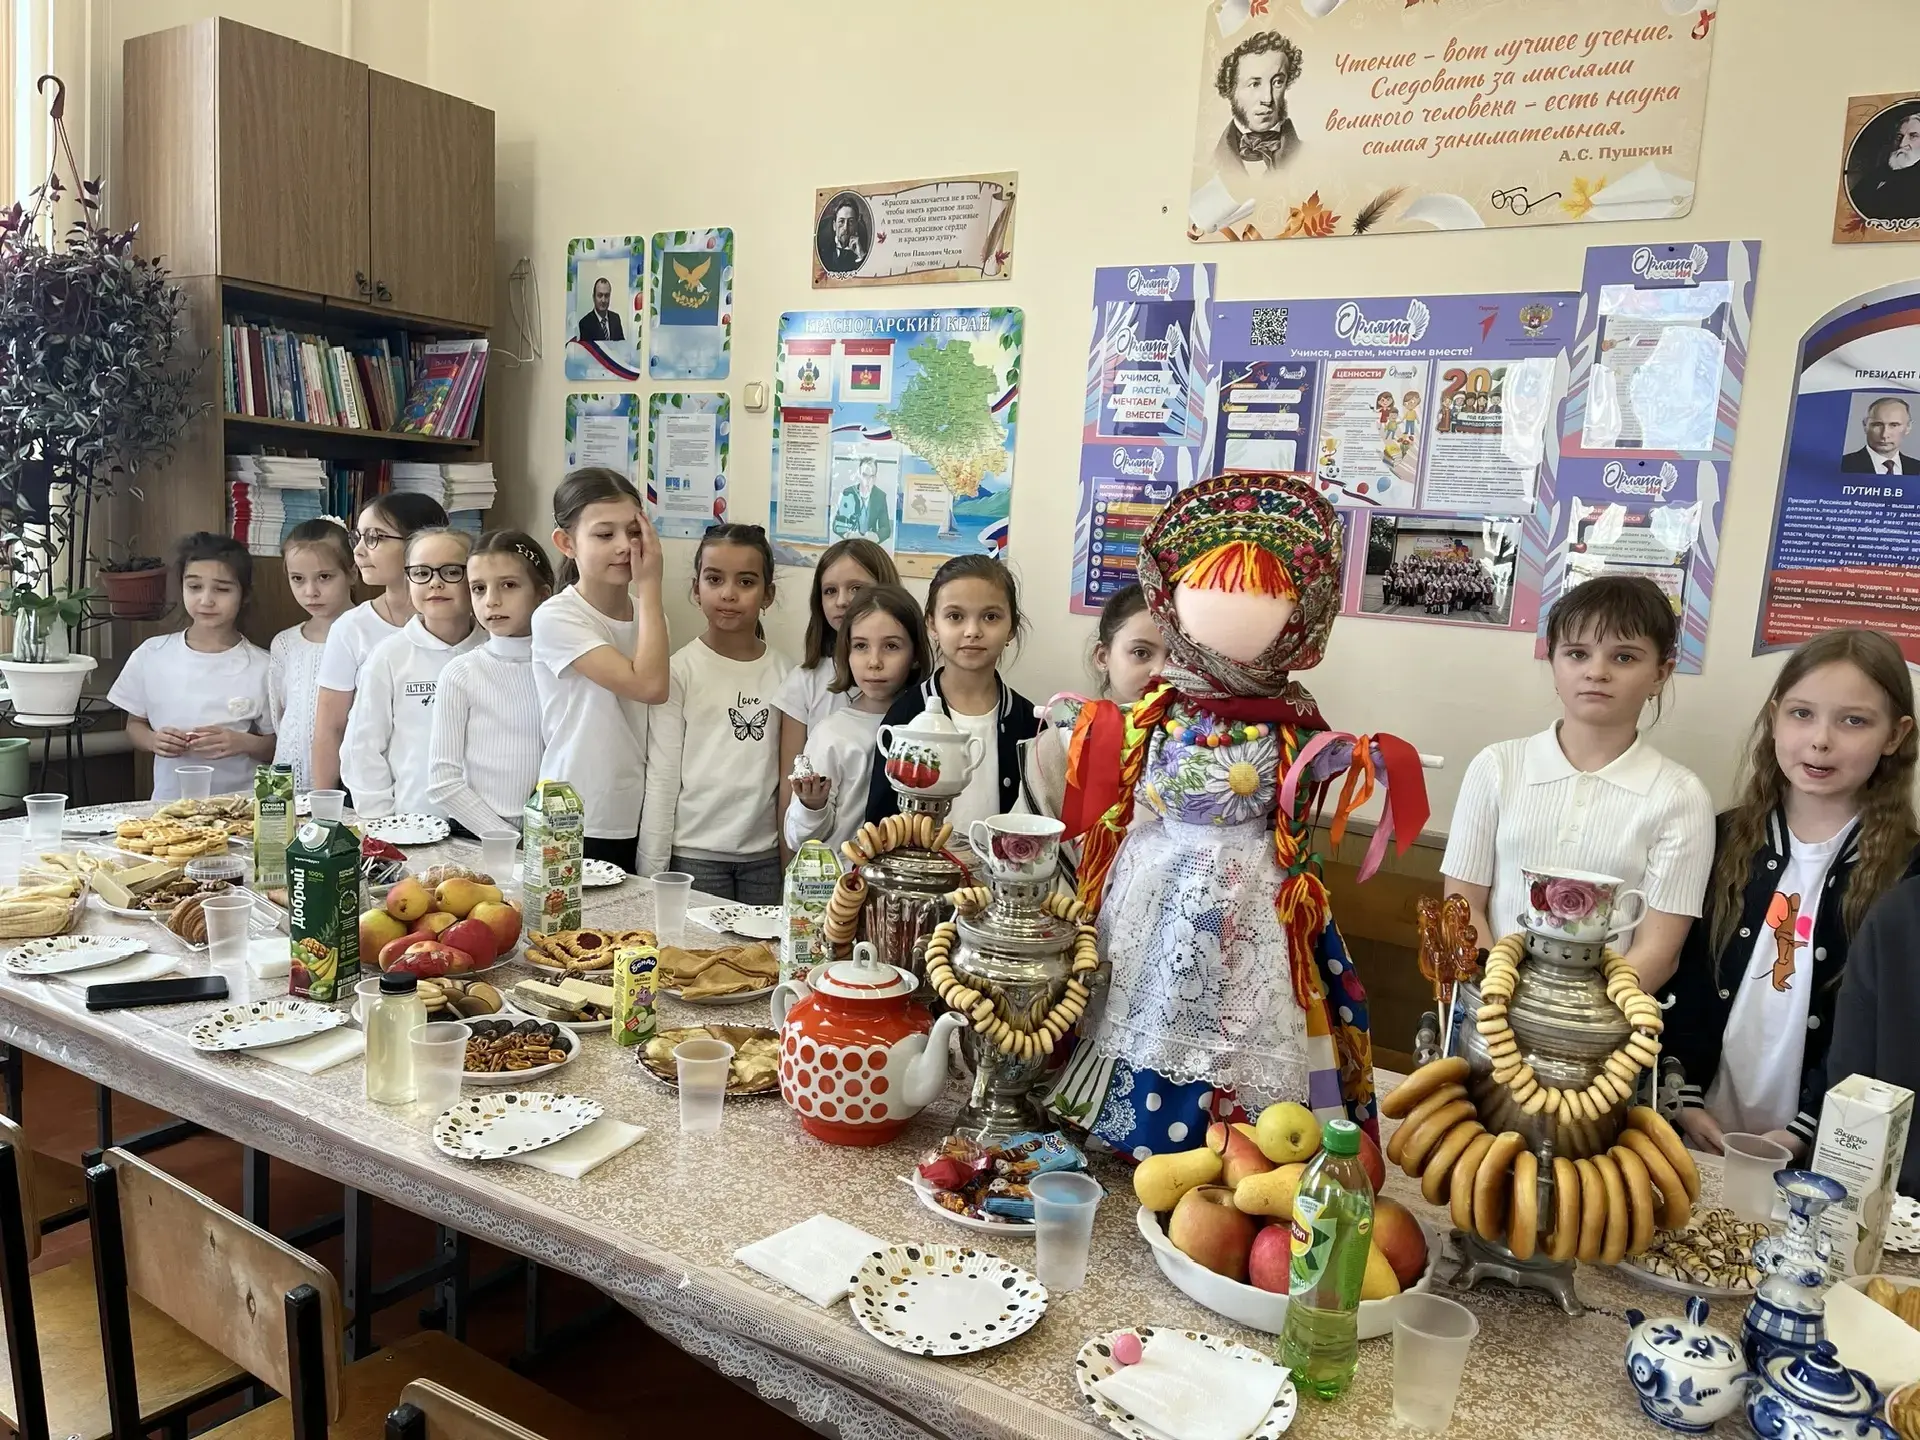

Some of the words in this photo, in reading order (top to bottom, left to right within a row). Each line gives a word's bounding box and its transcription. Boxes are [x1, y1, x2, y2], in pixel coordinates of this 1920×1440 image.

[1335, 52, 1416, 75] Чтение
[1443, 37, 1488, 62] вот
[1494, 33, 1578, 65] лучшее
[1579, 25, 1673, 57] учение.
[1371, 68, 1485, 105] Следовать
[1485, 72, 1515, 96] за
[1522, 60, 1634, 83] мыслями
[1325, 108, 1414, 131] великого
[1422, 93, 1516, 122] человека
[1544, 92, 1599, 112] есть
[1606, 86, 1681, 114] наука
[1362, 137, 1428, 155] самая
[1427, 121, 1625, 158] занимательная.
[1559, 148, 1593, 162] А.С.
[1599, 145, 1673, 161] Пушкин
[910, 196, 949, 204] заключается
[886, 207, 905, 215] чтобы
[926, 205, 956, 214] красивое
[881, 218, 886, 226] А
[907, 215, 927, 223] чтобы
[948, 213, 979, 222] красивые
[915, 226, 943, 236] красивое
[944, 223, 968, 232] сердце
[904, 235, 935, 244] красивую
[912, 249, 942, 257] Павлович
[1633, 247, 1694, 276] Орлята
[1129, 268, 1170, 290] Орлята
[804, 314, 941, 336] КРАСНОДАРСКИЙ
[945, 312, 991, 332] КРАЙ
[1338, 303, 1411, 340] Орлята
[1117, 328, 1169, 356] Орлята
[1290, 348, 1332, 358] Учимся,
[1378, 348, 1426, 357] мечтаем
[1428, 346, 1473, 357] вместе!
[1120, 373, 1161, 383] УЧИМСЯ,
[1855, 369, 1916, 379] ПРЕЗИДЕНТ
[1113, 397, 1157, 406] МЕЧТАЕМ
[1125, 410, 1164, 420] ВМЕСТЕ!
[1114, 448, 1154, 472] Орлята
[1604, 462, 1663, 490] Орлята
[1842, 486, 1881, 496] ПУТИН
[1883, 488, 1903, 497] В.В
[1784, 522, 1831, 530] исполнительный
[1873, 527, 1908, 535] приближены
[1778, 563, 1826, 571] Государственной
[1844, 567, 1883, 575] Подконтролен
[1804, 588, 1843, 596] Конституции
[1857, 584, 1893, 592] государства,
[1841, 600, 1900, 609] главнокомандующим
[1823, 617, 1861, 625] Конституцией
[1865, 620, 1898, 628] Российской
[308, 870, 325, 878] 100%
[798, 882, 806, 895] 4
[291, 867, 307, 930] Добрый
[1834, 1128, 1867, 1146] Вкусно
